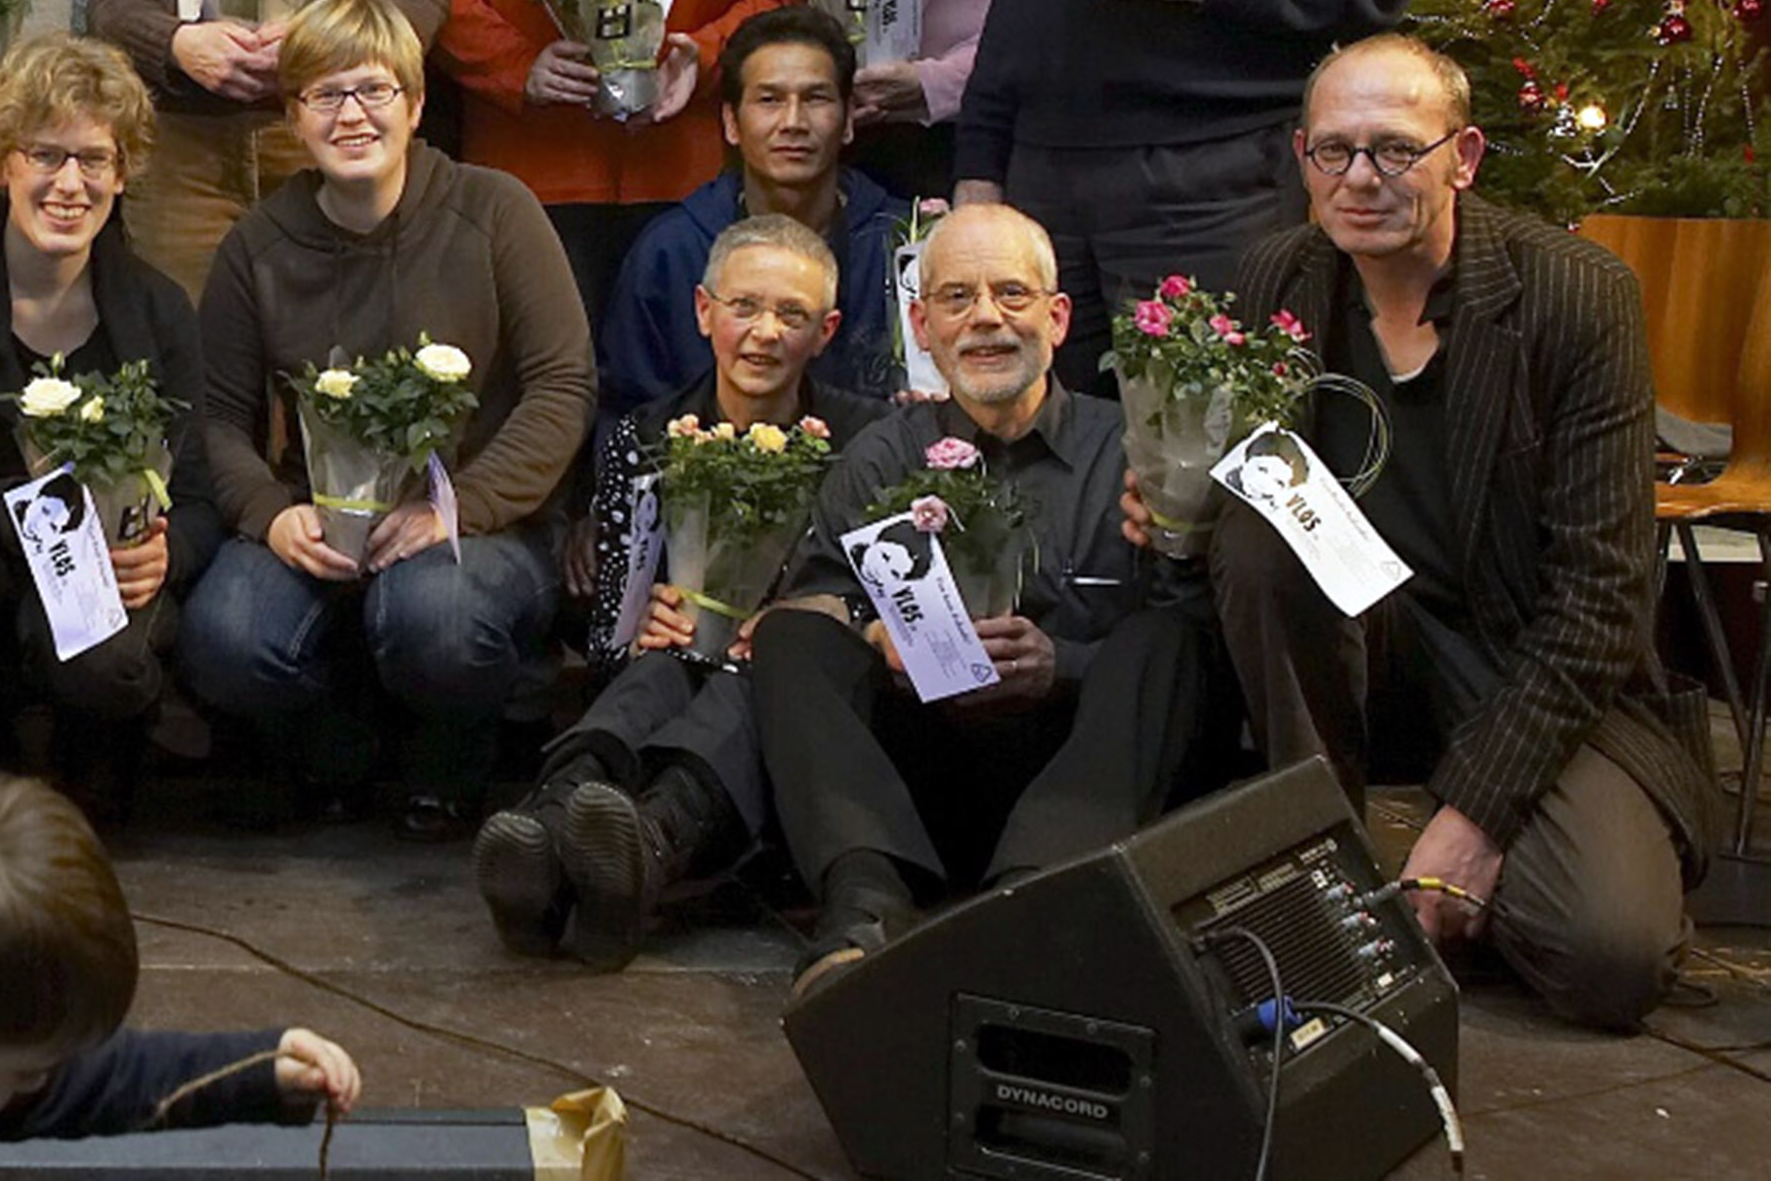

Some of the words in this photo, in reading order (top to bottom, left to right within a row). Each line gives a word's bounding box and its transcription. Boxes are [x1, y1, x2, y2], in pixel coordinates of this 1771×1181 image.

[1285, 493, 1322, 533] VLOS
[891, 585, 925, 625] VLOS
[997, 1084, 1108, 1119] DYNACORD
